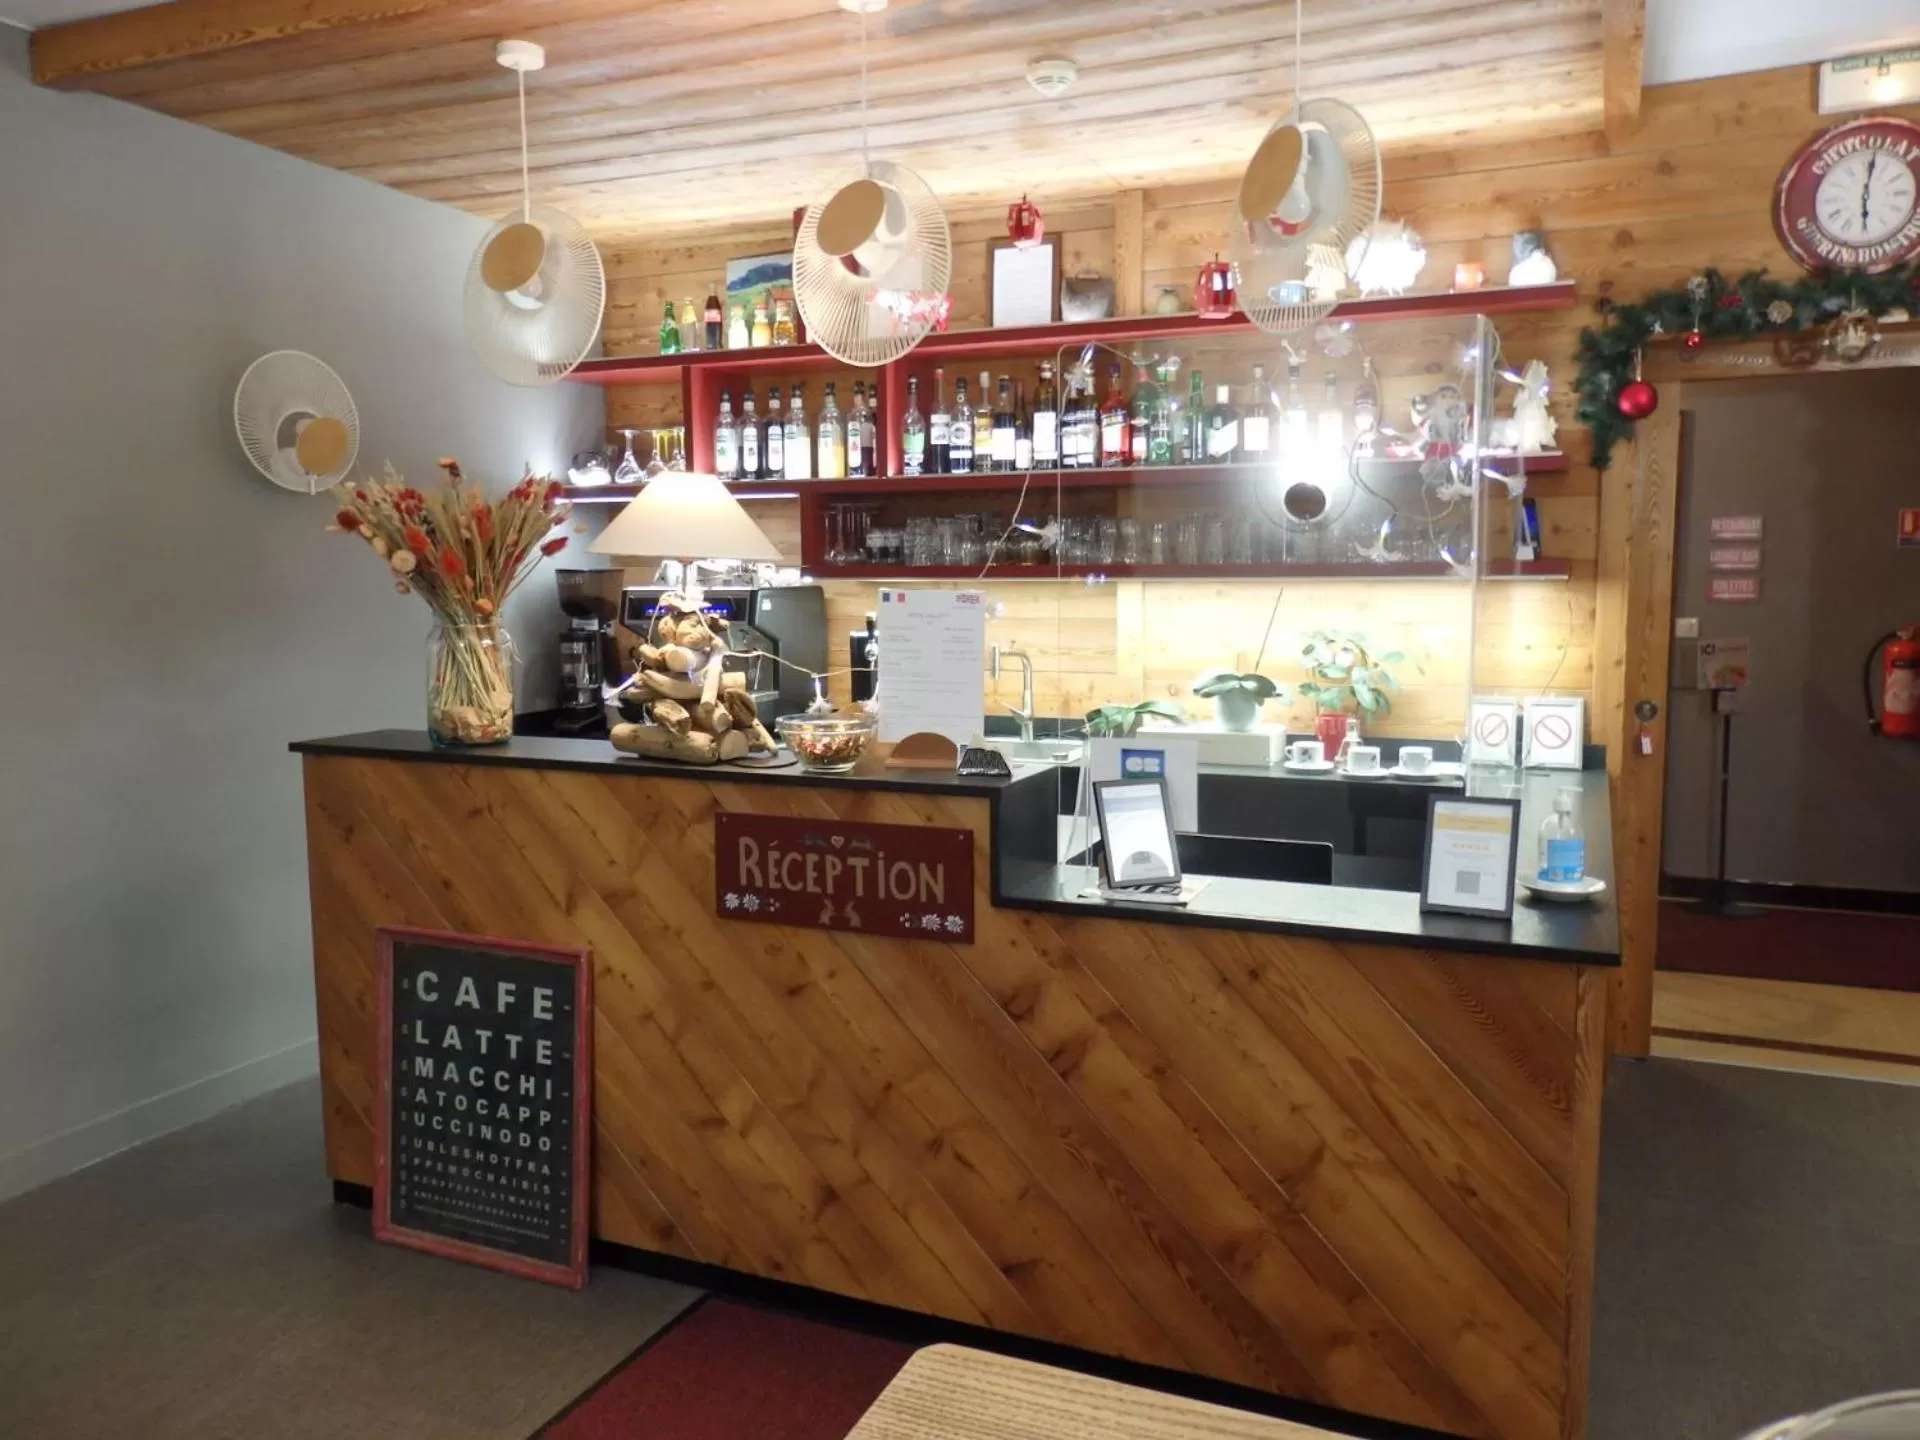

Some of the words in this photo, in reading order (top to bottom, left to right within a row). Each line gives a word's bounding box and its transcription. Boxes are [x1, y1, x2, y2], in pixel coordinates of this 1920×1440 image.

[415, 970, 554, 1021] CAFE
[415, 1019, 553, 1065] LATTE
[414, 1055, 552, 1100] MACCHI
[414, 1087, 551, 1127] ATOCAPP
[413, 1112, 551, 1152] UCCINODO
